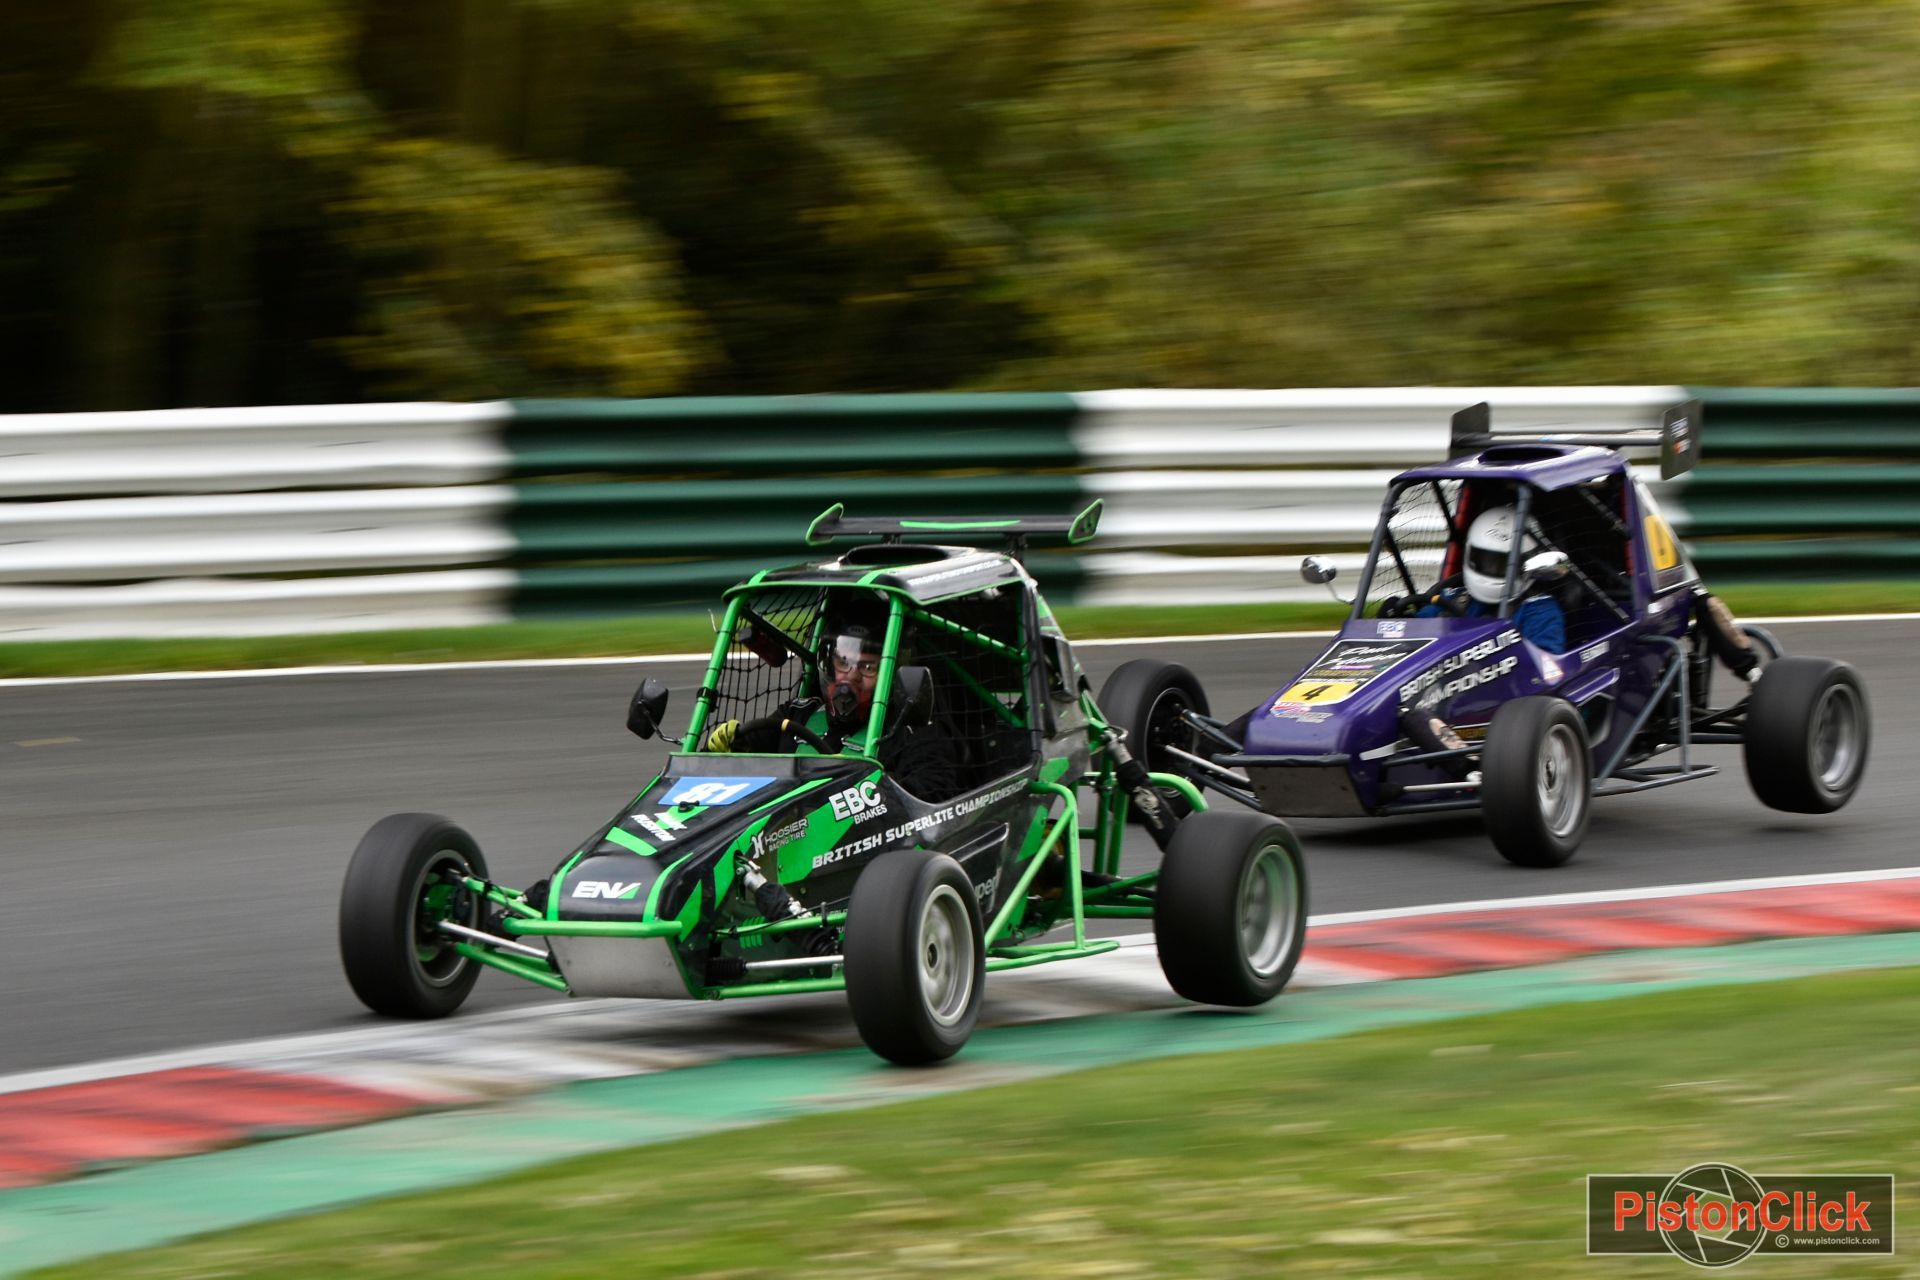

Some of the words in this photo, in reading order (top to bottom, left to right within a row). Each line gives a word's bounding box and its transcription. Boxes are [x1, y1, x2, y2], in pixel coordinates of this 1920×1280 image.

[1399, 667, 1444, 702] BRITISH
[1444, 628, 1522, 675] SUPERLITE
[1301, 684, 1333, 701] 4
[672, 782, 751, 804] 81
[828, 781, 882, 822] EBC
[811, 833, 883, 869] BRITISH
[886, 807, 954, 843] SUPERLITE
[955, 778, 1029, 817] CHAMPIONSHIP
[853, 803, 888, 825] BRAKES
[764, 817, 809, 846] HOOSIER
[768, 836, 791, 852] RACING
[790, 829, 807, 846] TIRE
